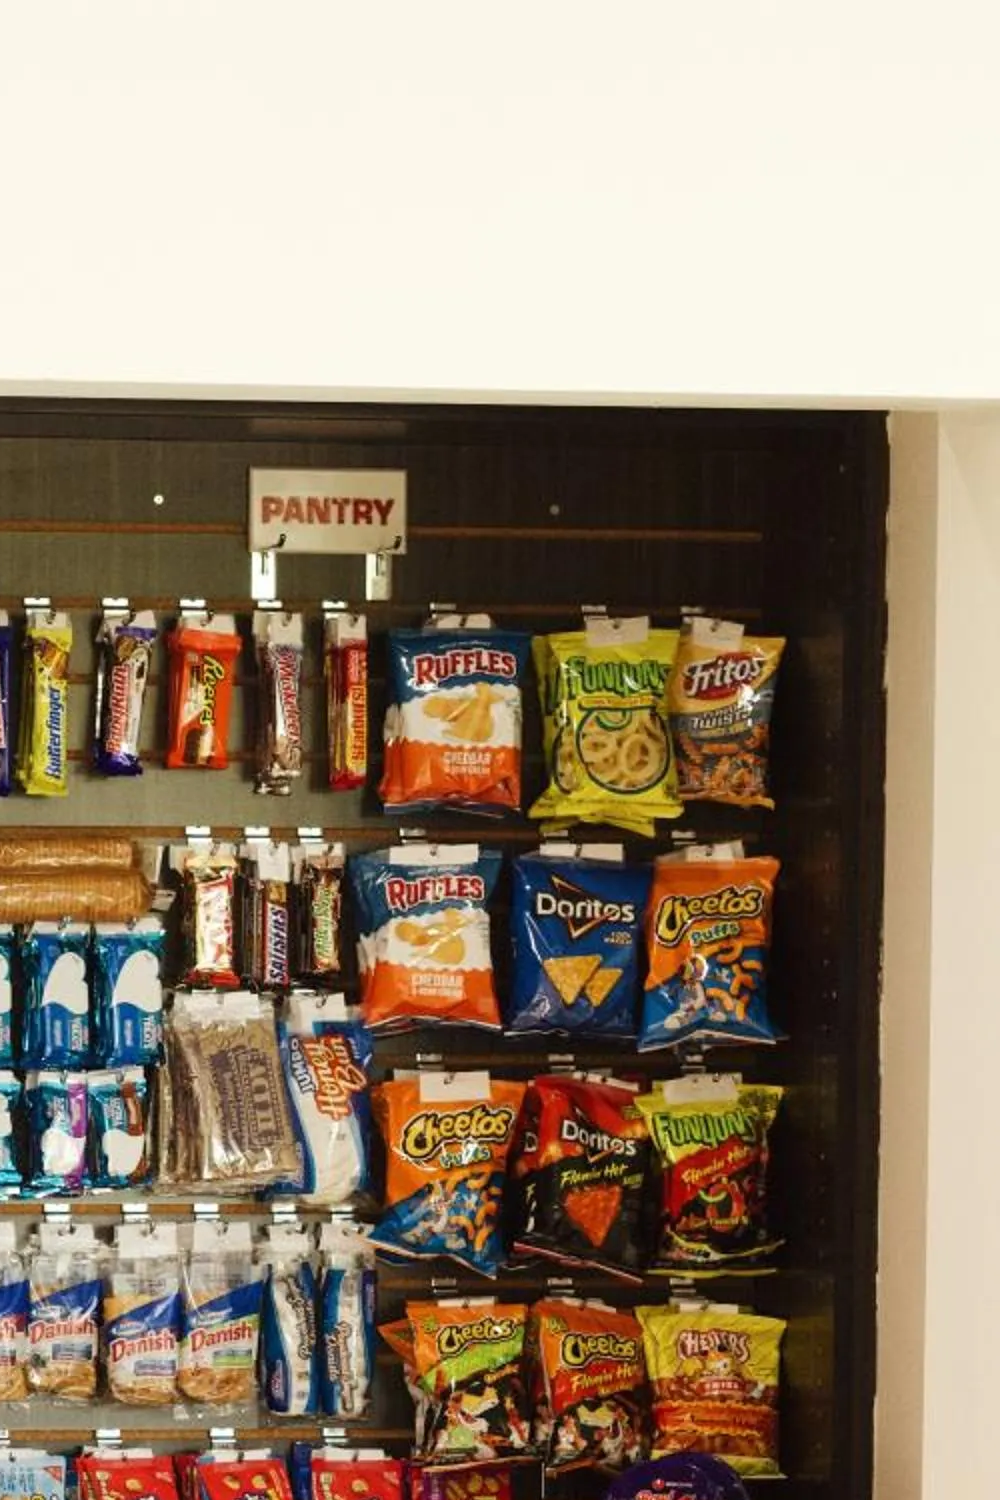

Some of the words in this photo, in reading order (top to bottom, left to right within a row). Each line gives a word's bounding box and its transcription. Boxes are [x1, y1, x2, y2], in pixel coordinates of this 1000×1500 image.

[261, 496, 395, 526] PANTRY
[414, 648, 517, 686] RUFFLES
[684, 655, 765, 695] Fritos
[386, 876, 485, 911] RUFFLES
[537, 893, 636, 923] Doritos
[656, 885, 763, 943] Cheetos
[403, 1105, 513, 1158] Cheetos
[561, 1119, 637, 1155] Doritos
[29, 1317, 94, 1345] Danish
[110, 1328, 176, 1364] Danish
[190, 1321, 253, 1352] Danish
[437, 1317, 517, 1356] Cheetos
[561, 1332, 638, 1369] Cheetos
